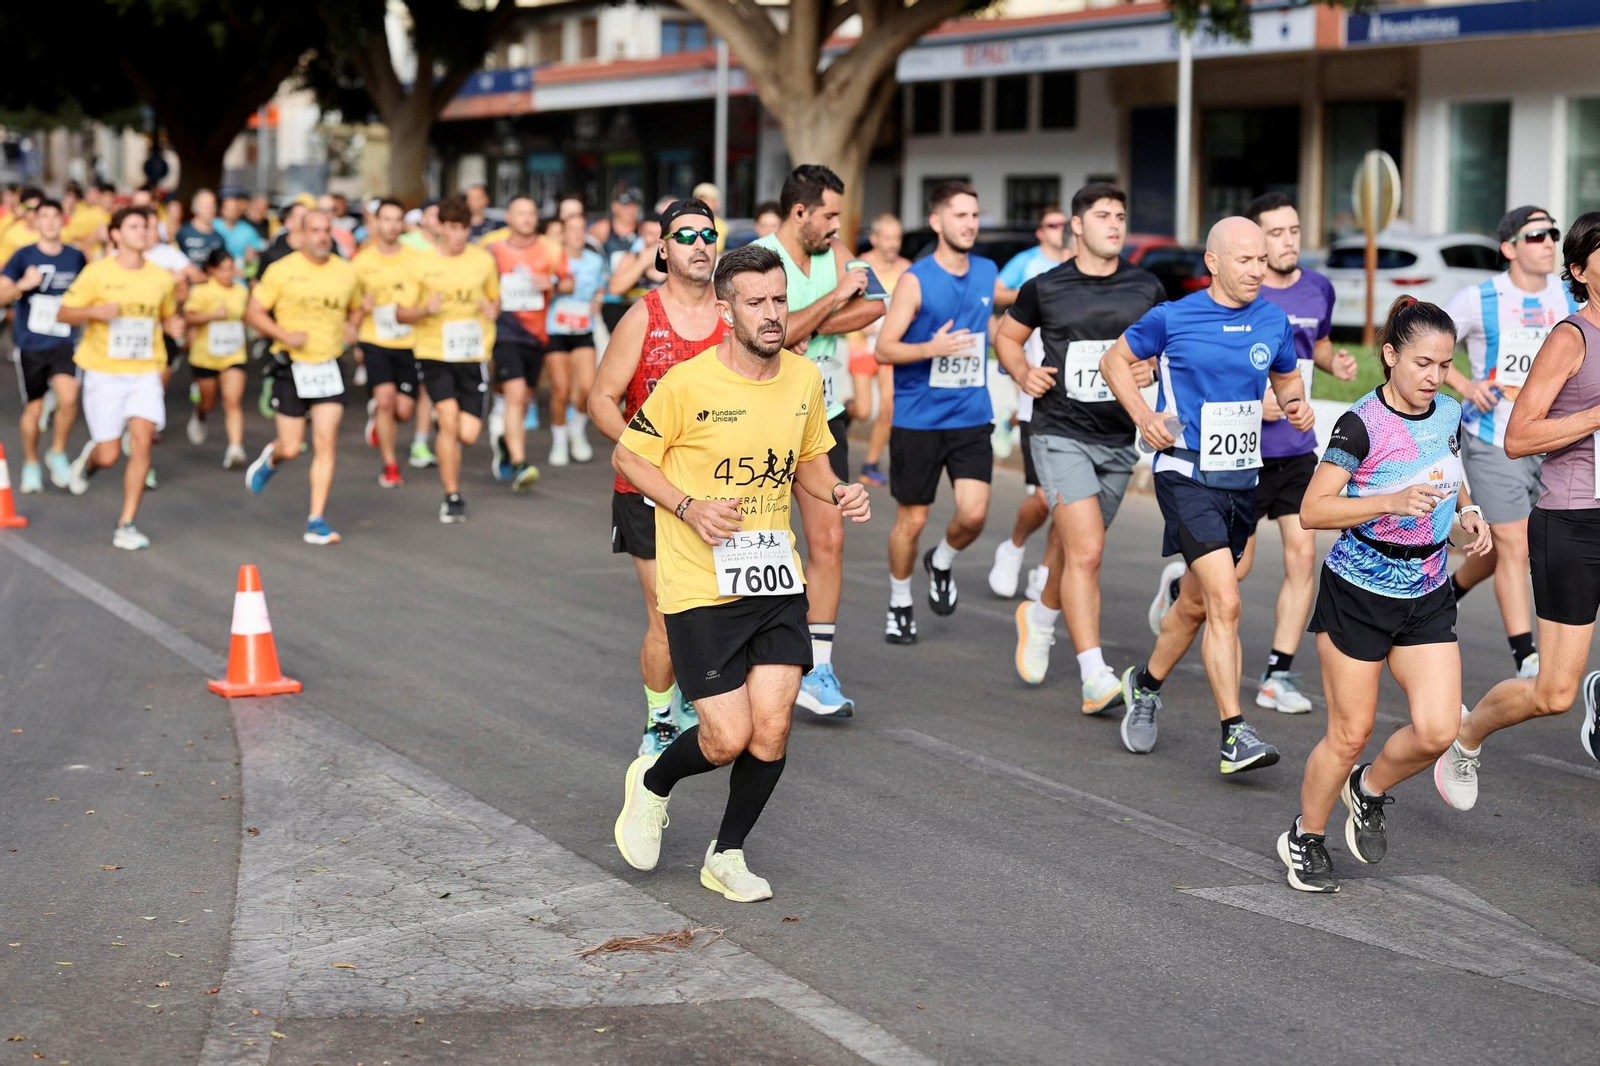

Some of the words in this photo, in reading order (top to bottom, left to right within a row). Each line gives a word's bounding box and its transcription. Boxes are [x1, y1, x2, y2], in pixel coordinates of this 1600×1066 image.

[650, 329, 669, 338] vive
[939, 356, 980, 373] 8579
[712, 409, 746, 417] Fundación
[712, 415, 738, 423] Unicaja
[1209, 431, 1257, 455] 2039
[714, 457, 755, 486] 45
[726, 536, 752, 549] 45
[725, 564, 794, 594] 7600
